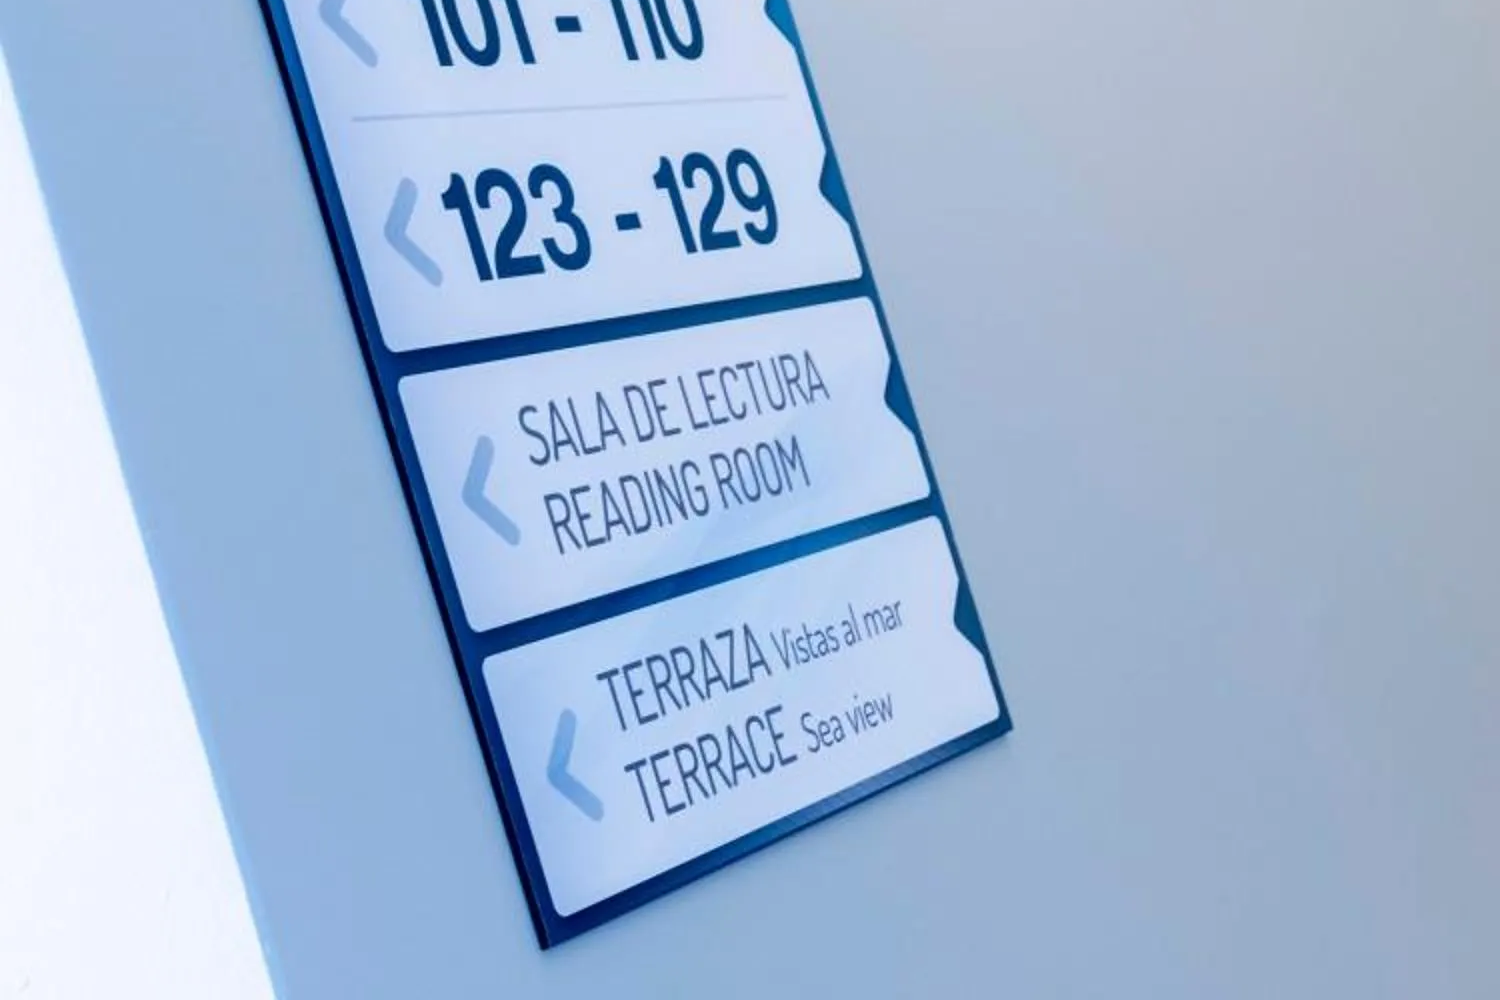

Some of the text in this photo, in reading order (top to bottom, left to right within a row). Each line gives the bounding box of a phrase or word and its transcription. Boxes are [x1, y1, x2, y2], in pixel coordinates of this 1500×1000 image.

[555, 15, 582, 33] -
[441, 147, 779, 283] 123 - 129
[518, 350, 830, 466] SALA DE LECTURA
[544, 435, 811, 555] READING ROOM
[596, 597, 904, 732] TERRAZA Vistas al mar
[623, 689, 894, 823] TERRACE Sea view
